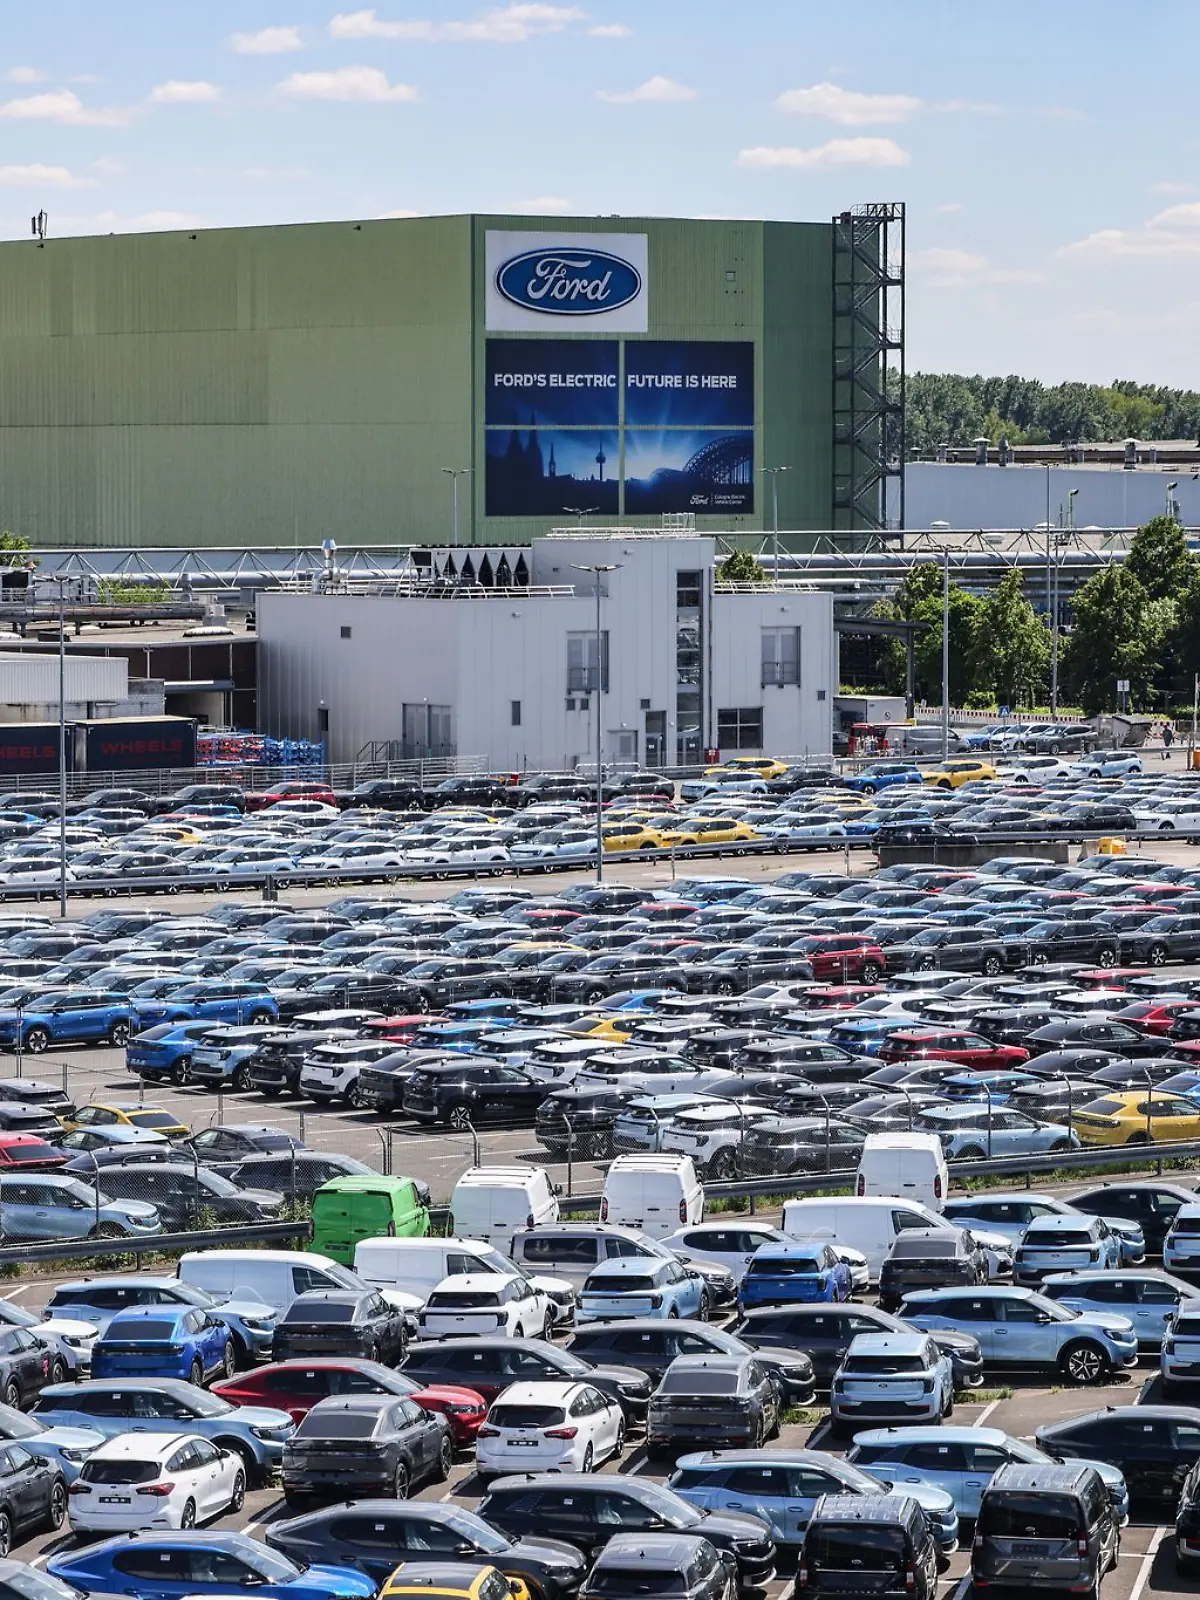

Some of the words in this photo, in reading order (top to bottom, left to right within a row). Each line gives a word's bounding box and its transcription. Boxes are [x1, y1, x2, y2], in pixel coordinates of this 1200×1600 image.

[527, 258, 612, 301] Ford
[494, 374, 546, 387] FORD'S
[549, 374, 617, 387] ELECTRIC
[627, 375, 682, 388] FUTURE
[685, 375, 699, 388] IS
[701, 375, 737, 388] HERE
[101, 739, 183, 755] WHEELS
